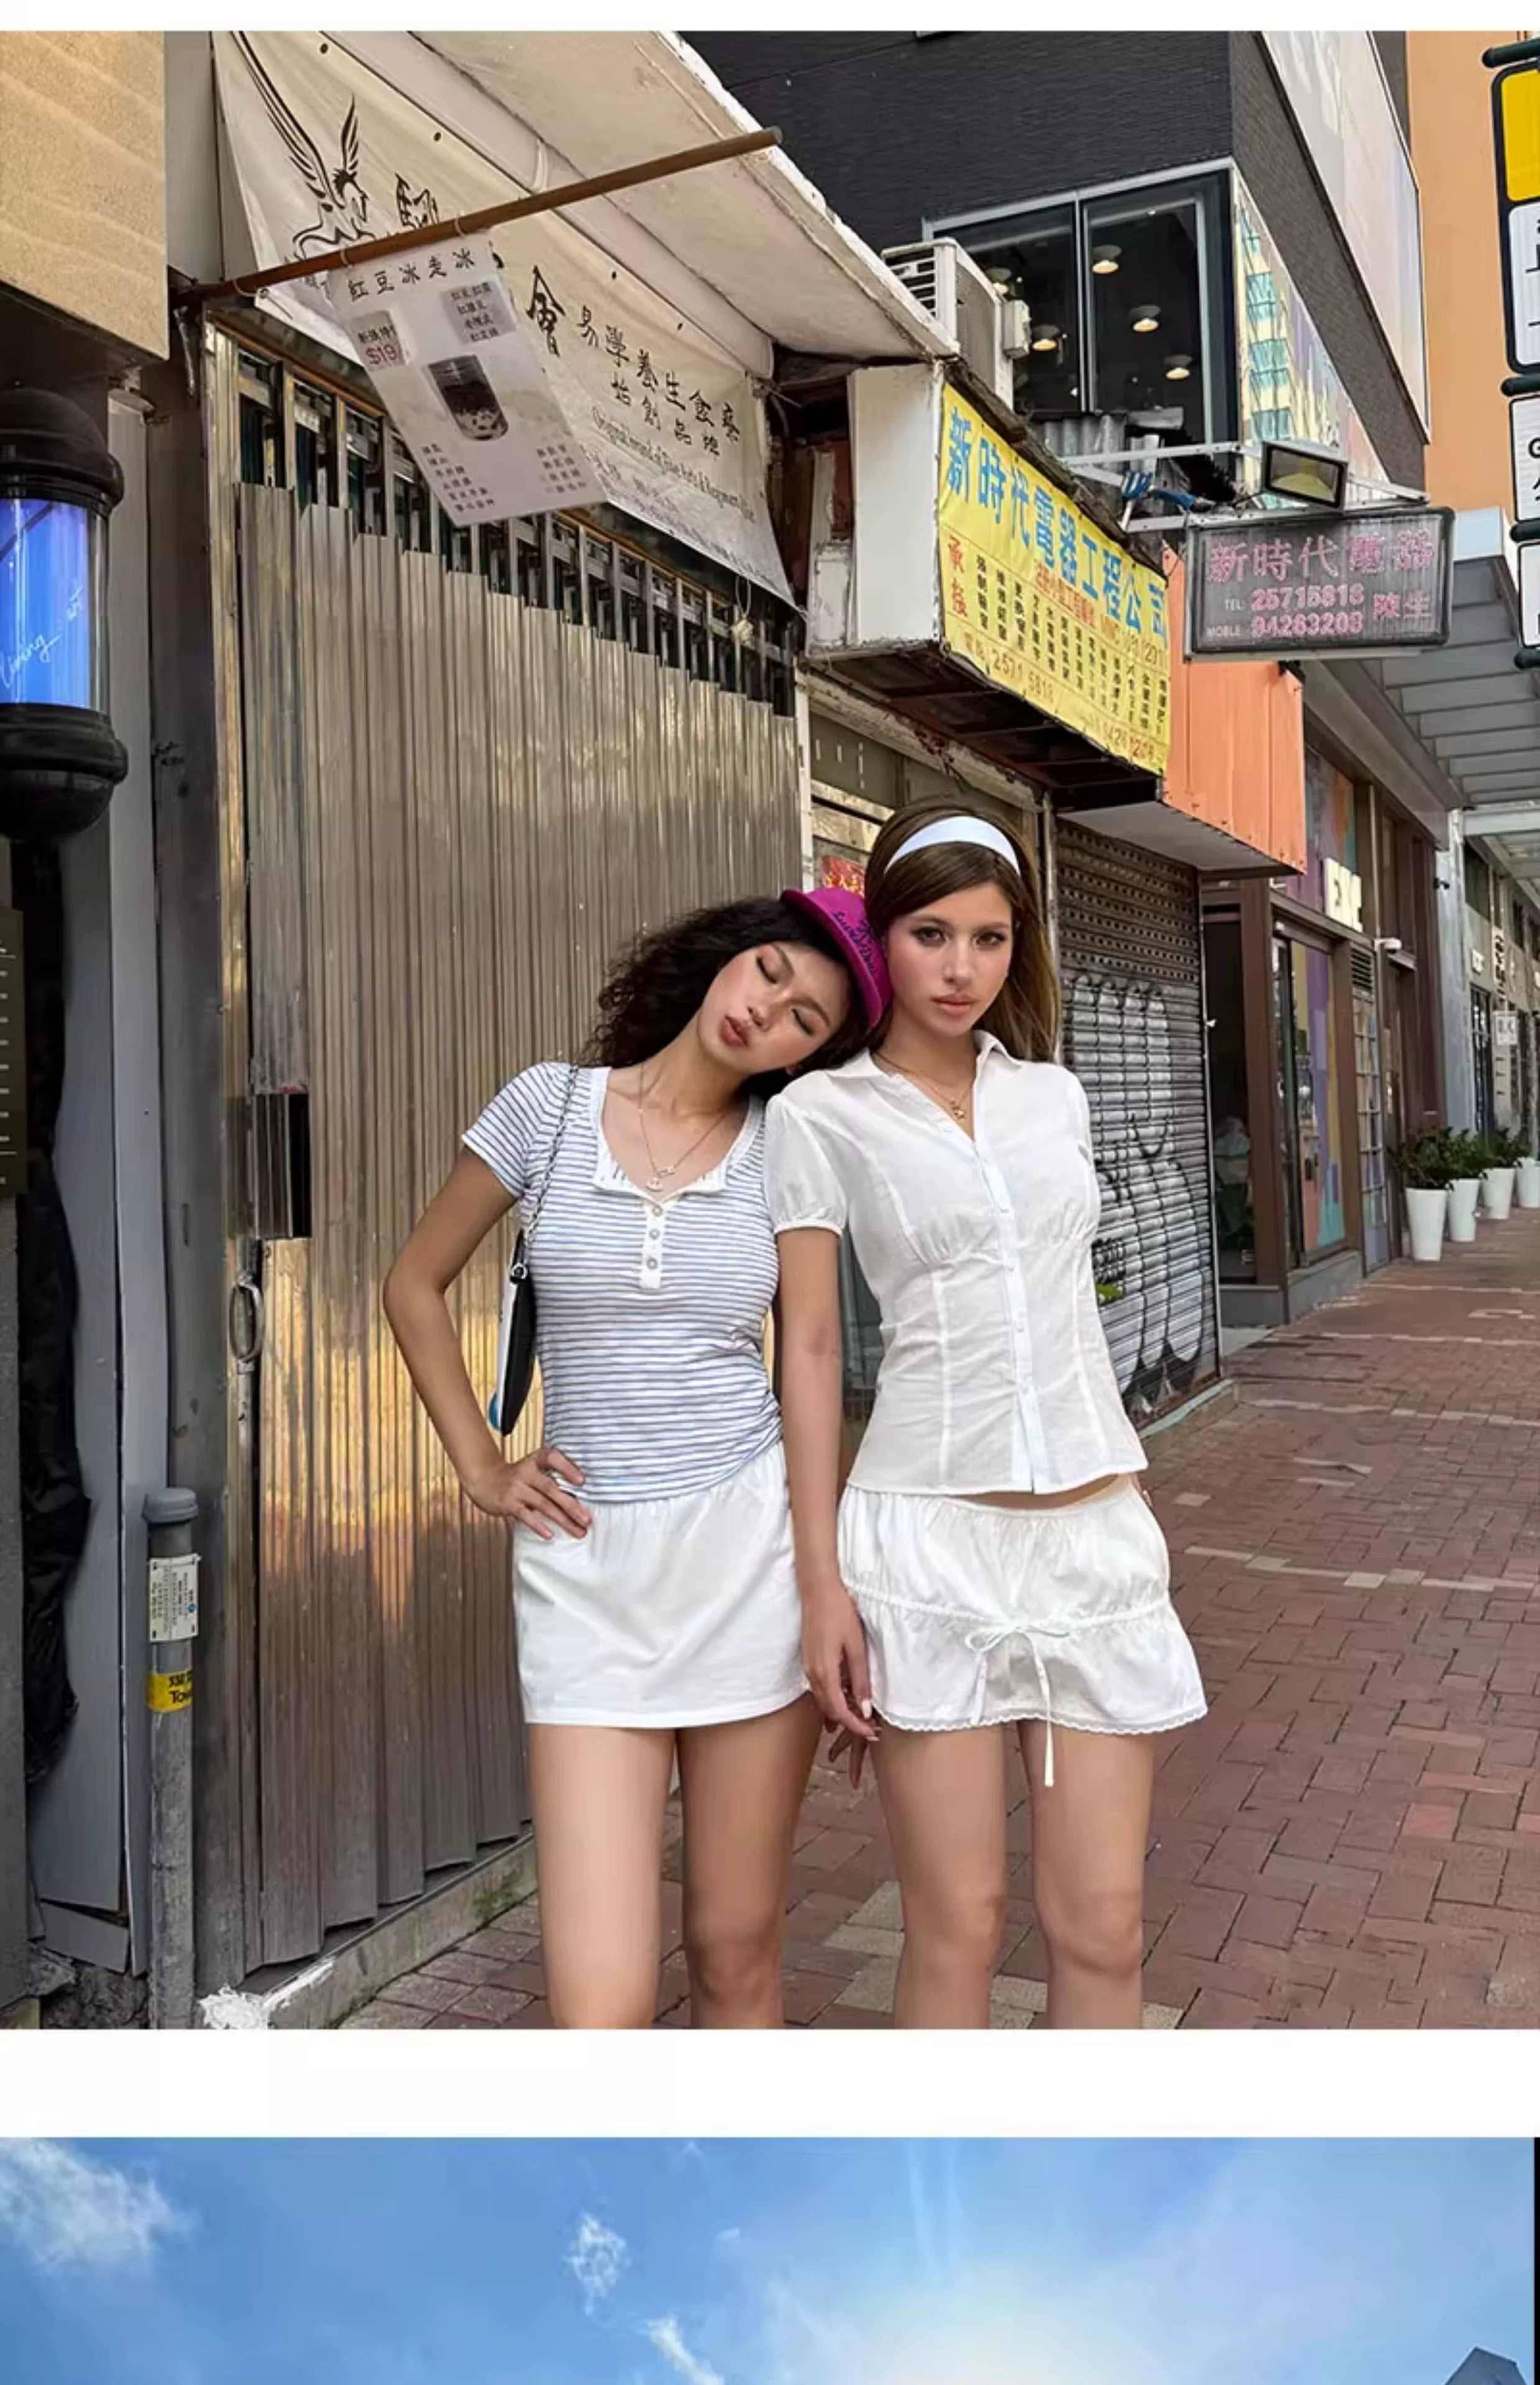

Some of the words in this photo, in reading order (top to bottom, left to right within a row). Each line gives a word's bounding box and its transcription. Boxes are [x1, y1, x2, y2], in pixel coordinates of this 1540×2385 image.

[948, 406, 1168, 650] 新時代電器工程公司
[1207, 528, 1434, 583] 新時代電器
